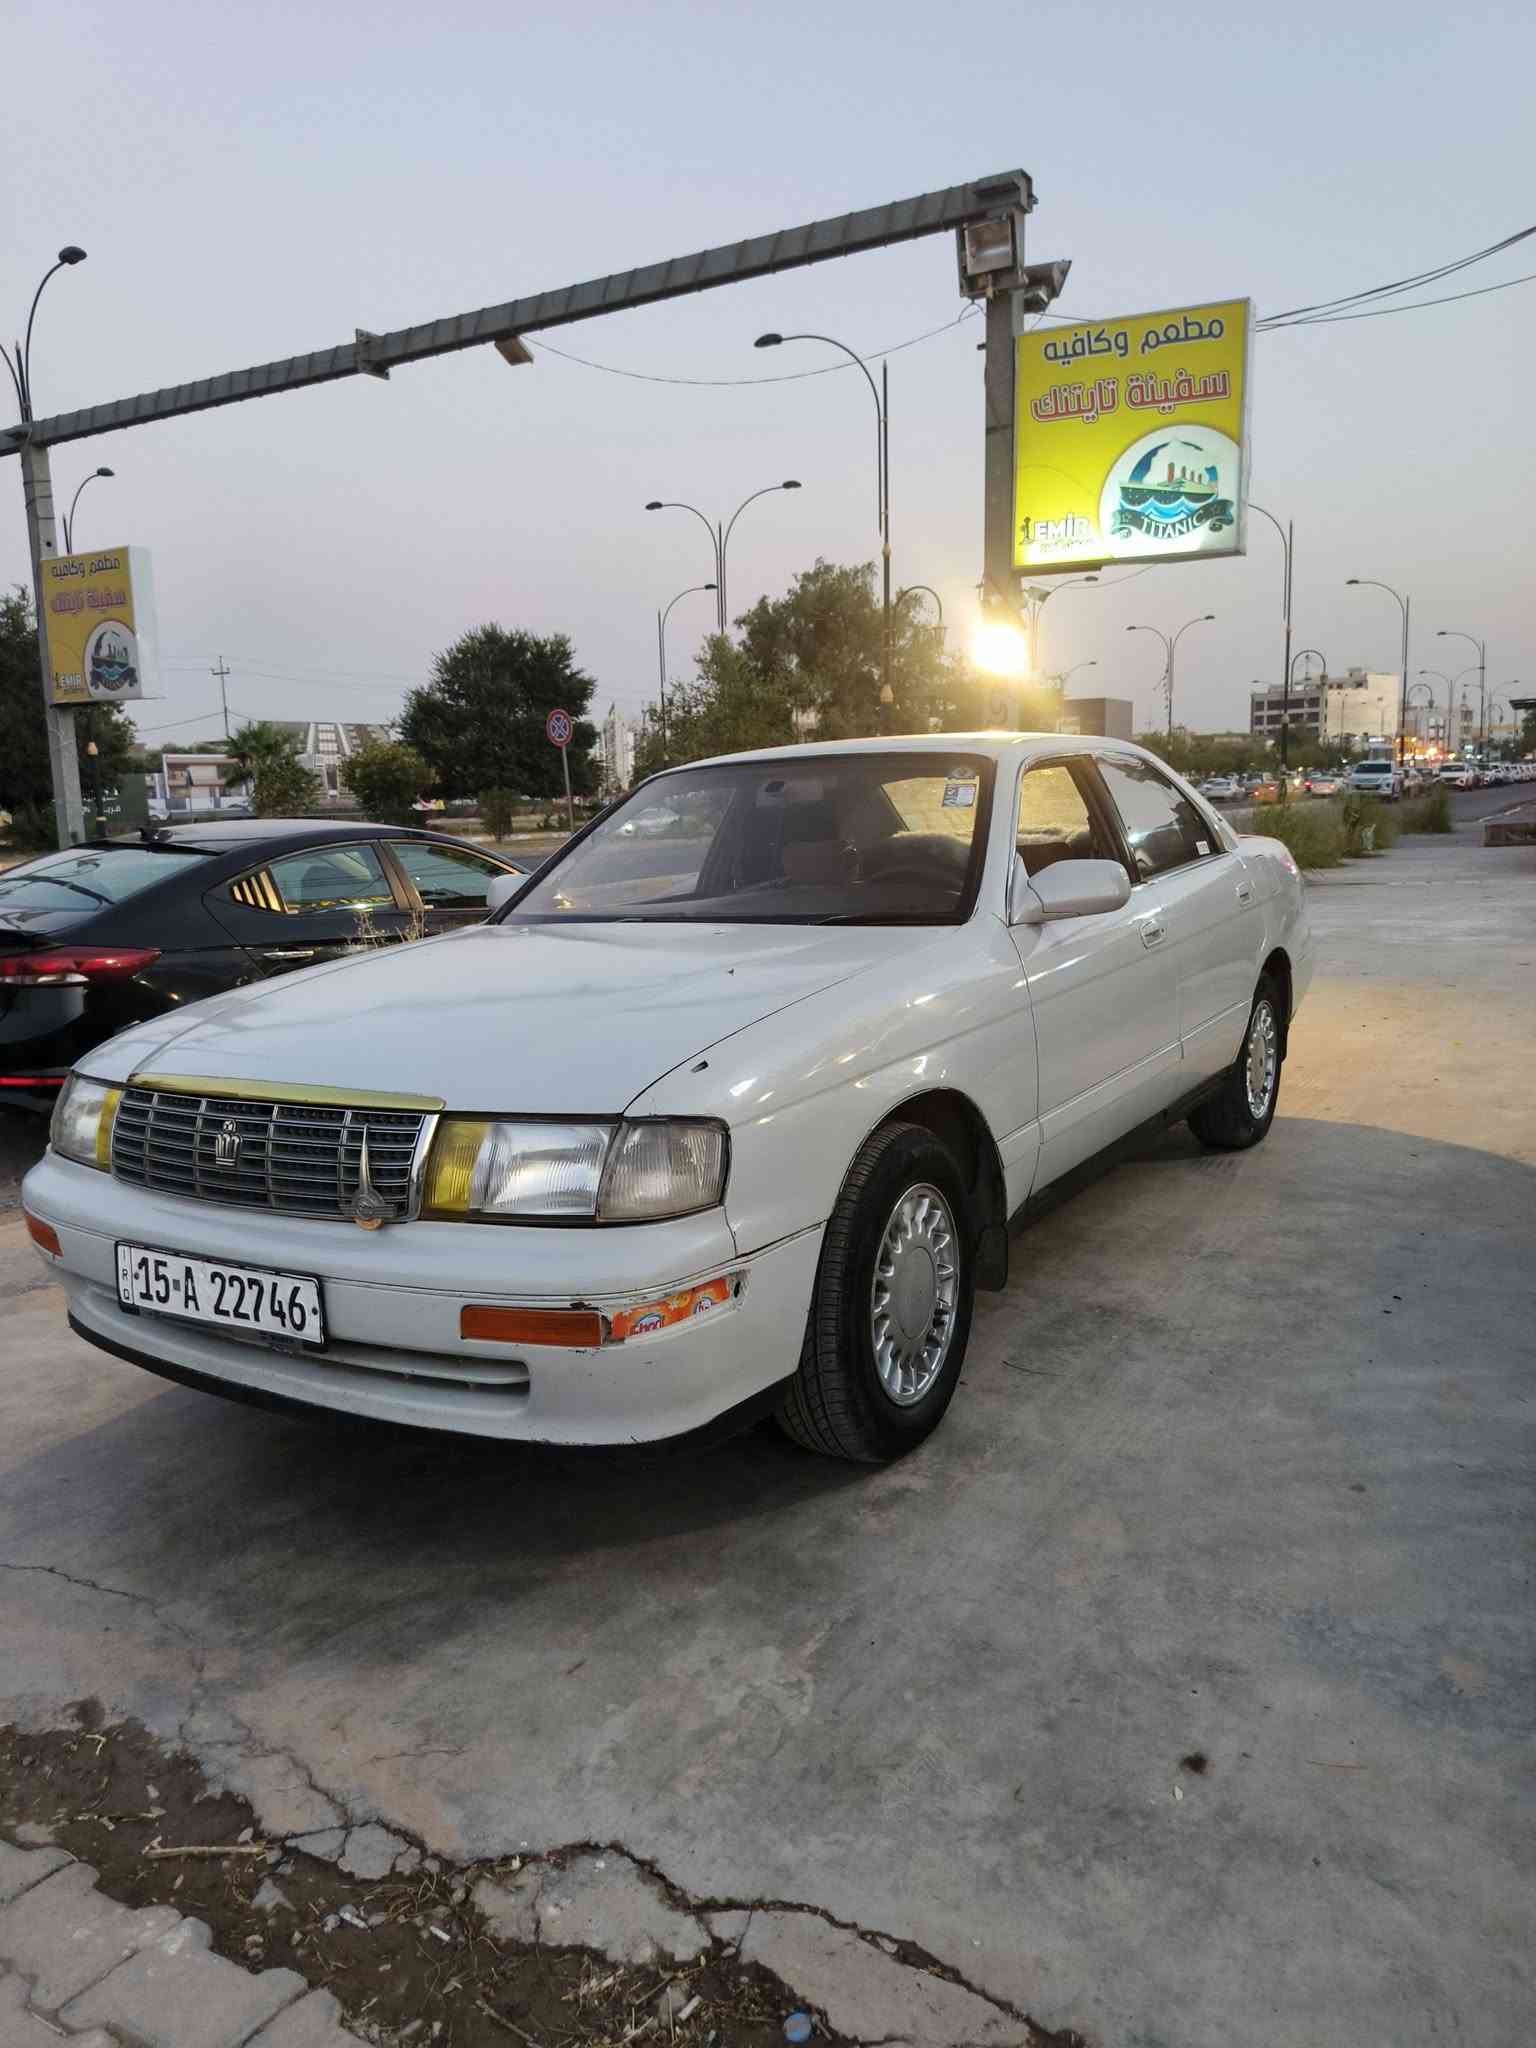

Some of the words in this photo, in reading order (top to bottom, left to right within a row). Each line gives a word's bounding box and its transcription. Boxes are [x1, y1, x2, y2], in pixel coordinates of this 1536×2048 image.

[1043, 328, 1129, 366] وكافيه
[1141, 316, 1224, 354] مطعم
[1031, 377, 1120, 423] تايتنك
[1126, 369, 1231, 414] سفينة
[1141, 509, 1203, 539] TITANIC
[210, 1271, 306, 1332] 22746
